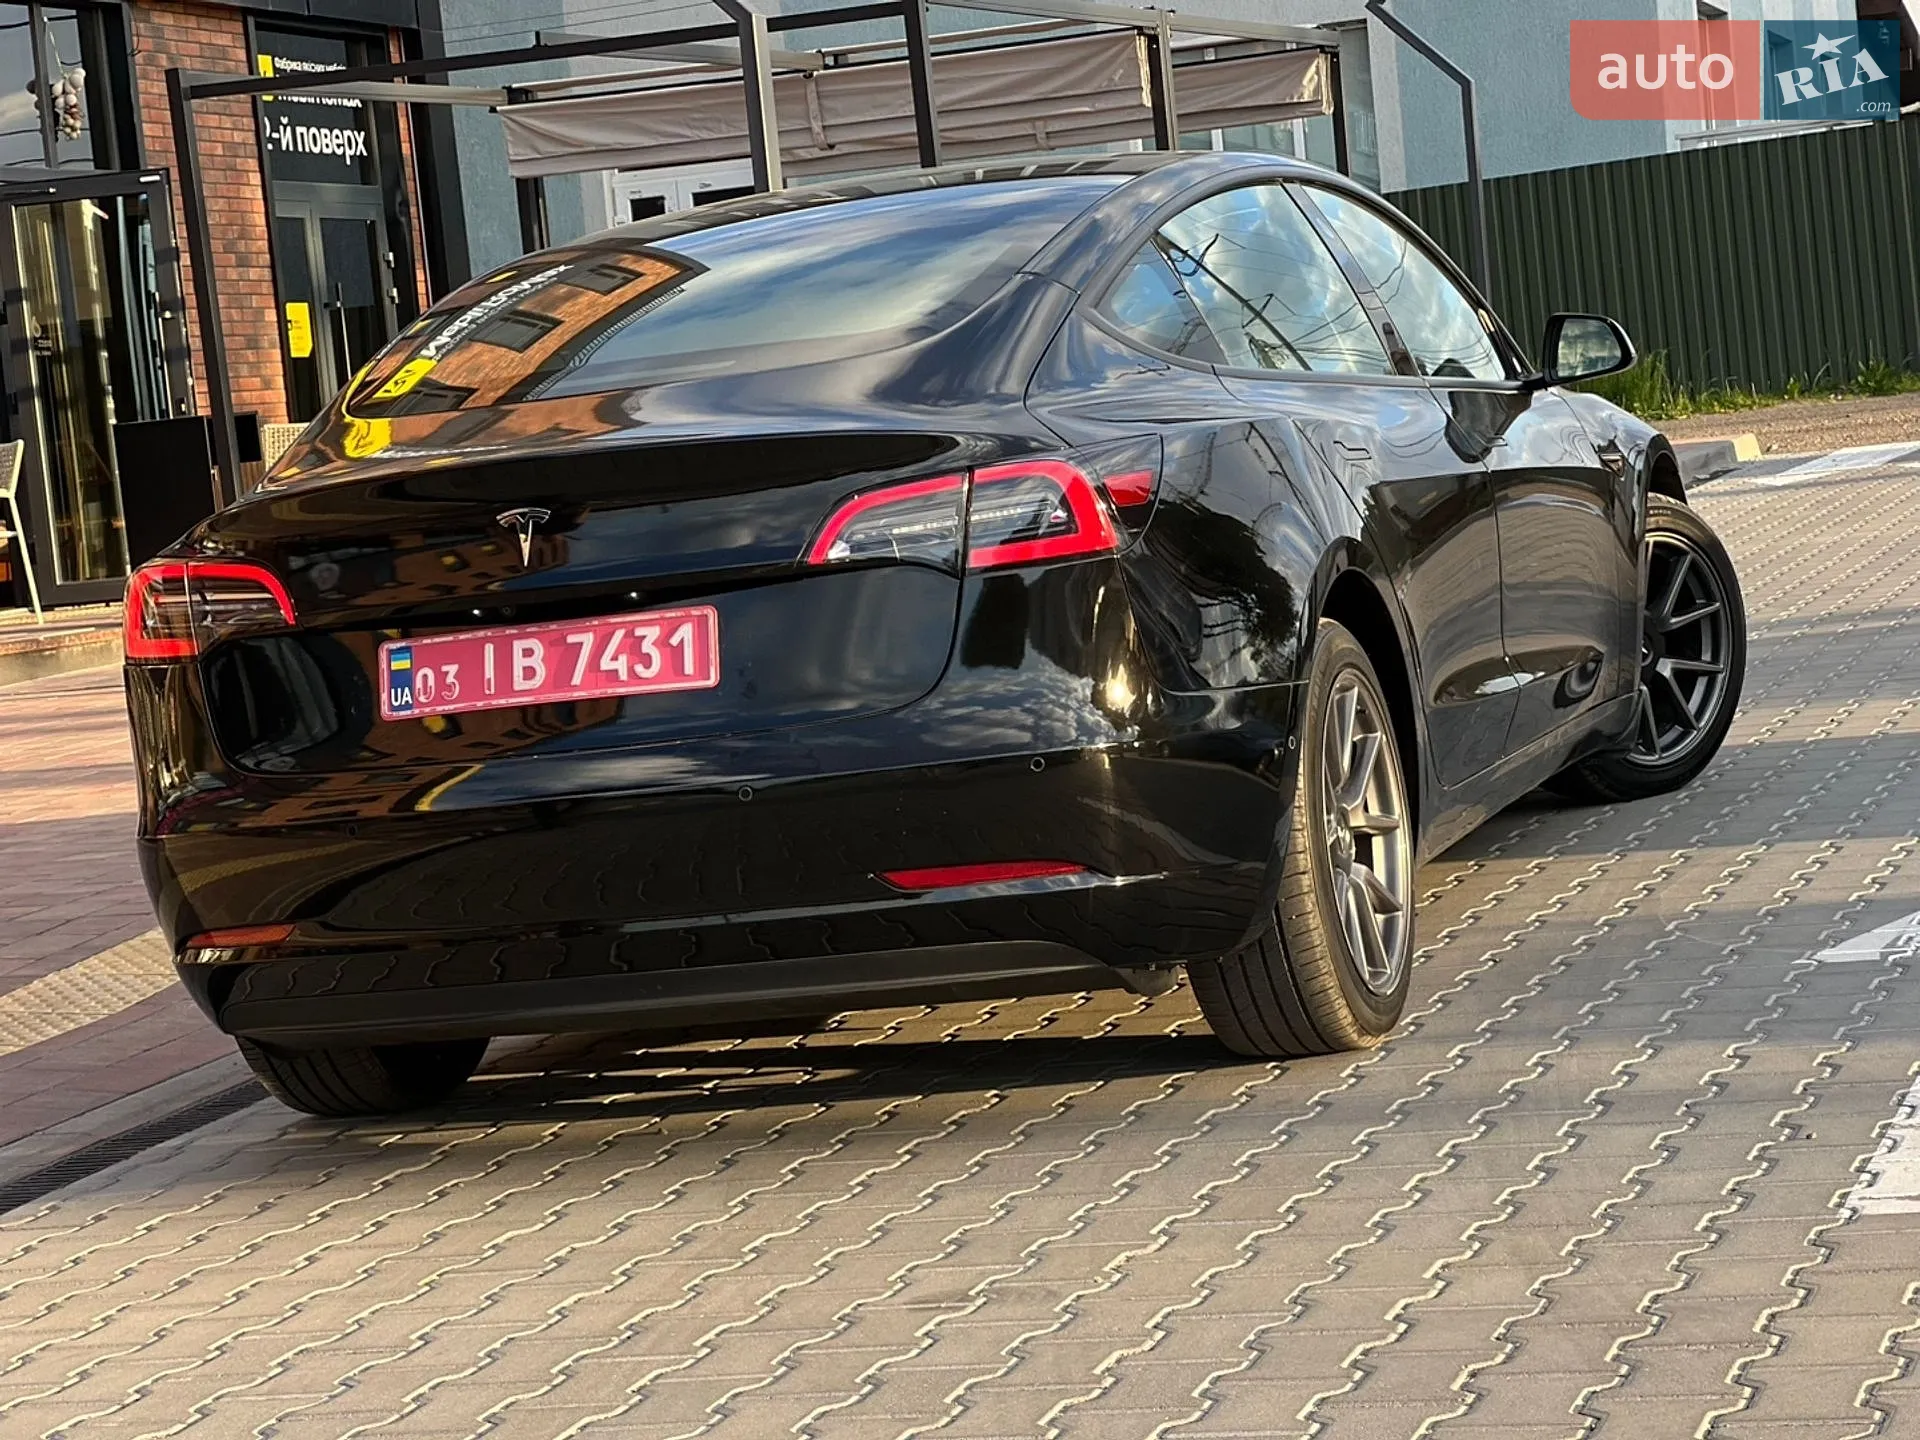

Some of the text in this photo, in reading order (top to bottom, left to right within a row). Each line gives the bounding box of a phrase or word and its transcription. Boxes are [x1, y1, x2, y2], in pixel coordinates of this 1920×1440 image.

[295, 126, 368, 166] поверх
[415, 622, 695, 704] 03 IB 7431
[391, 687, 413, 706] UA
